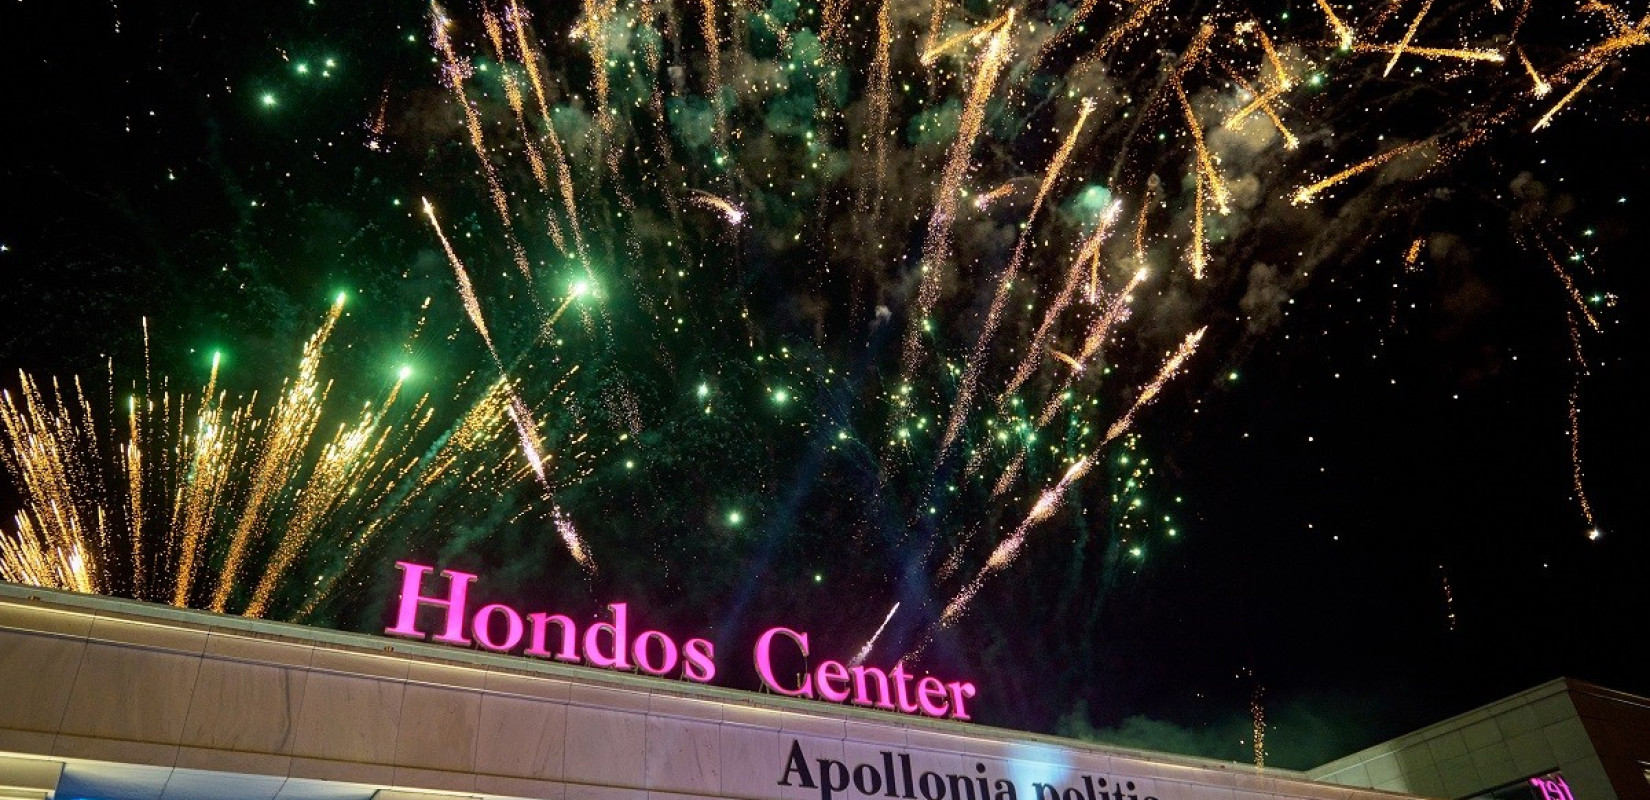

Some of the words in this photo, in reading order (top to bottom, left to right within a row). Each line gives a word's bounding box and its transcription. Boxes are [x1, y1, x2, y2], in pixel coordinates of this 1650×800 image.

[384, 560, 717, 683] Hondos
[753, 626, 977, 720] Center
[777, 738, 1018, 800] Apollonia
[1032, 774, 1159, 800] politi
